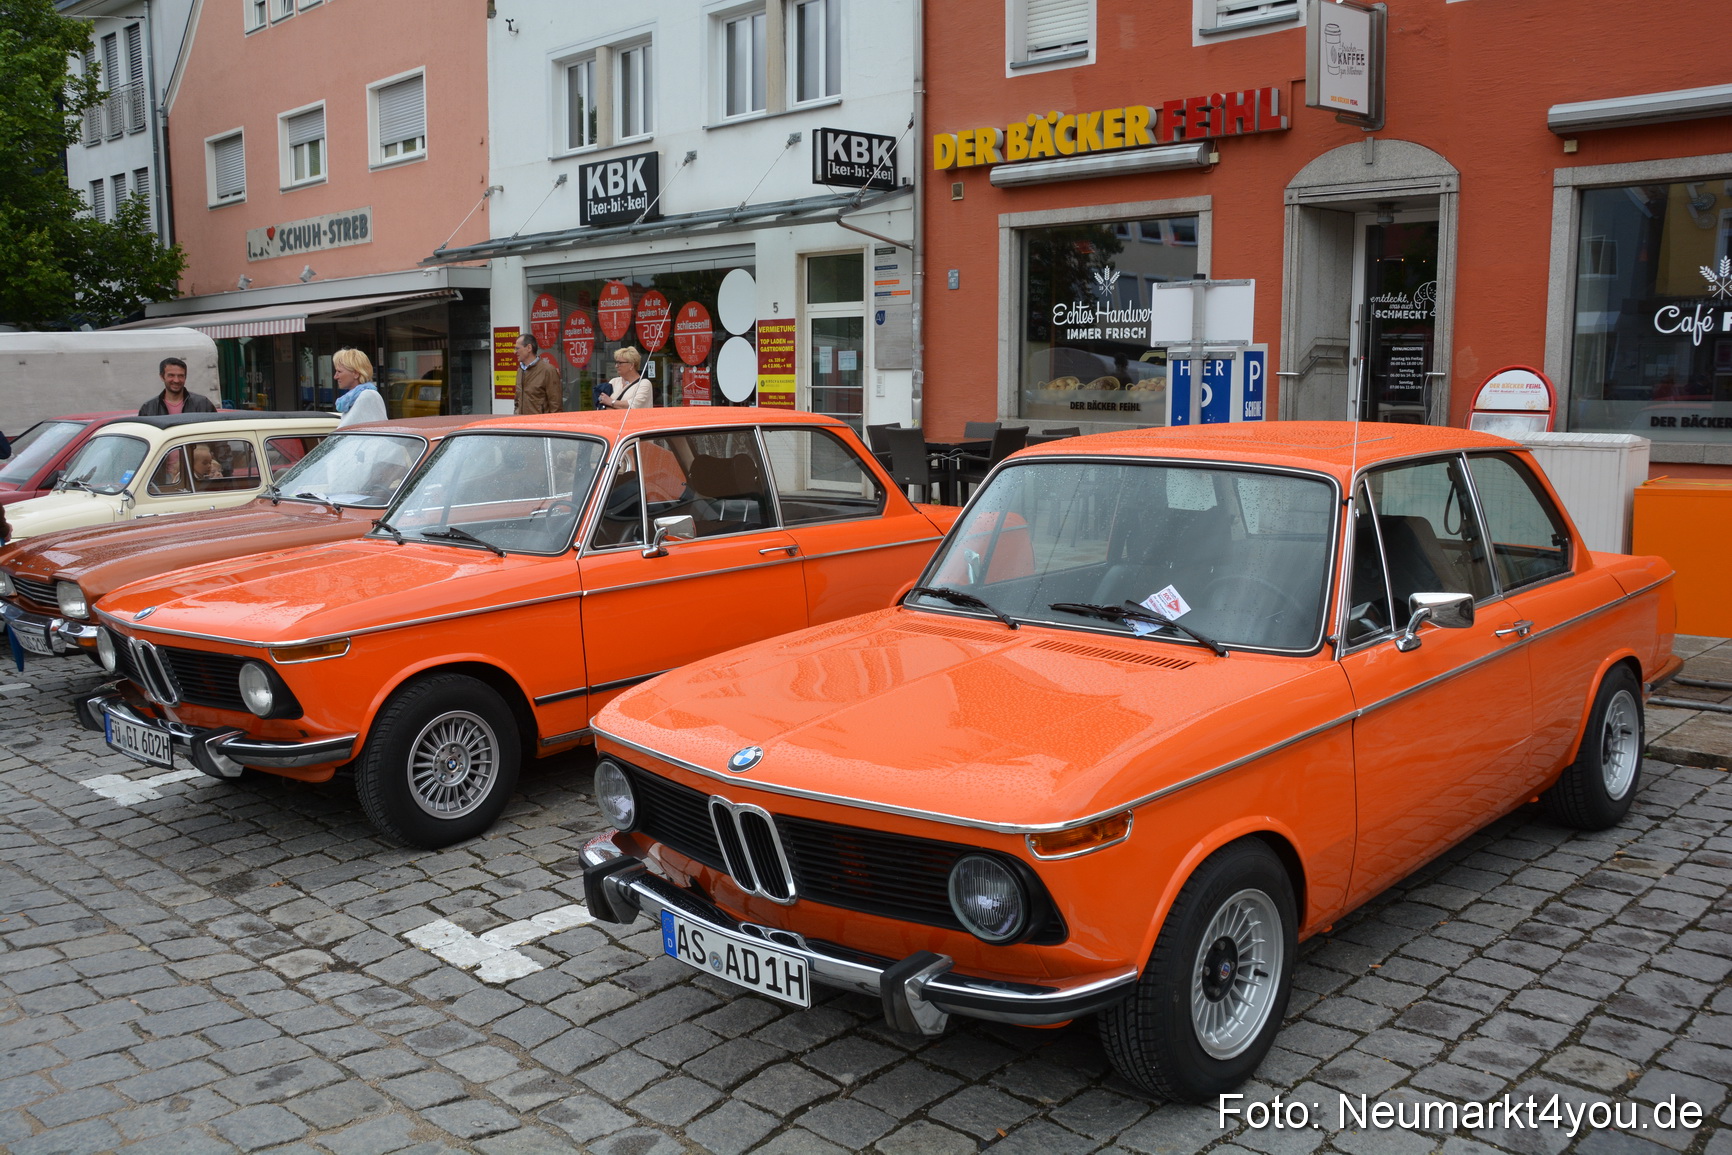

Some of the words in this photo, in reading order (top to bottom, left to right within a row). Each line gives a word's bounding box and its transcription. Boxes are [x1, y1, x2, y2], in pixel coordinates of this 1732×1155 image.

[1338, 52, 1365, 66] KAFFEE
[933, 127, 1003, 171] DER
[1007, 105, 1156, 162] BÄCKER
[827, 132, 893, 167] KBK
[586, 157, 647, 199] KBK
[610, 286, 618, 295] Wir
[541, 299, 549, 307] Wir
[773, 302, 778, 313] 5
[688, 307, 697, 317] Wir
[1052, 301, 1094, 326] Echtes
[1375, 310, 1428, 319] SCHMECKT
[582, 326, 592, 334] Teile
[643, 324, 663, 339] 20%
[759, 325, 796, 333] VERMIETUNG
[1654, 304, 1714, 346] Café
[1067, 328, 1101, 340] IMMER
[1105, 327, 1146, 339] FRISCH
[569, 341, 588, 356] 20%
[1180, 360, 1224, 376] HER
[1249, 360, 1260, 392] P
[1070, 401, 1084, 410] DER
[1087, 400, 1116, 411] BÄCKER
[1650, 416, 1677, 428] DER
[1681, 414, 1732, 428] BÄCKER
[111, 718, 121, 743] FÜ
[126, 725, 139, 751] GI
[141, 730, 170, 761] 602H
[667, 937, 673, 948] D
[678, 923, 707, 965] AS
[726, 943, 805, 1000] AD1H
